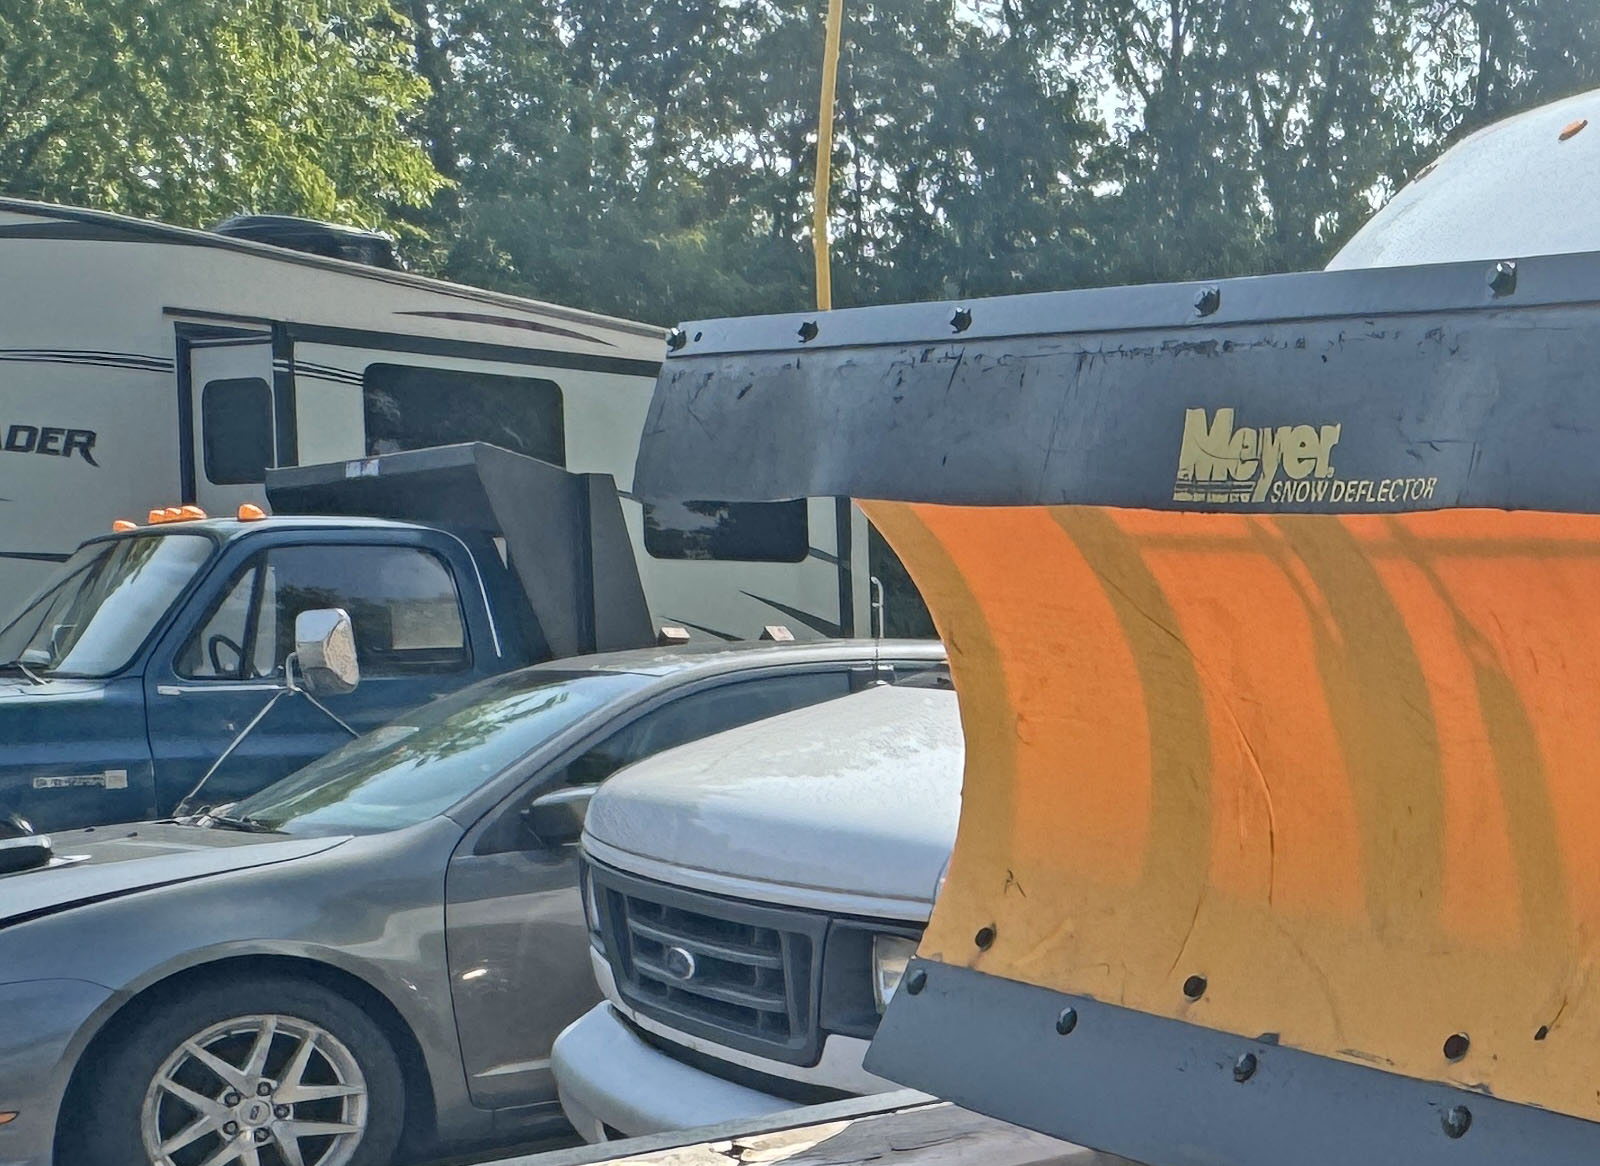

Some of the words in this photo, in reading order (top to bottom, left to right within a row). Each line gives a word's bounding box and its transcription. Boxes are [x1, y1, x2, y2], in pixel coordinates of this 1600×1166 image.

[0, 424, 100, 468] DER
[1178, 408, 1341, 502] Meyer
[1271, 480, 1329, 503] SNOW
[1330, 478, 1438, 503] DEFLECTOR
